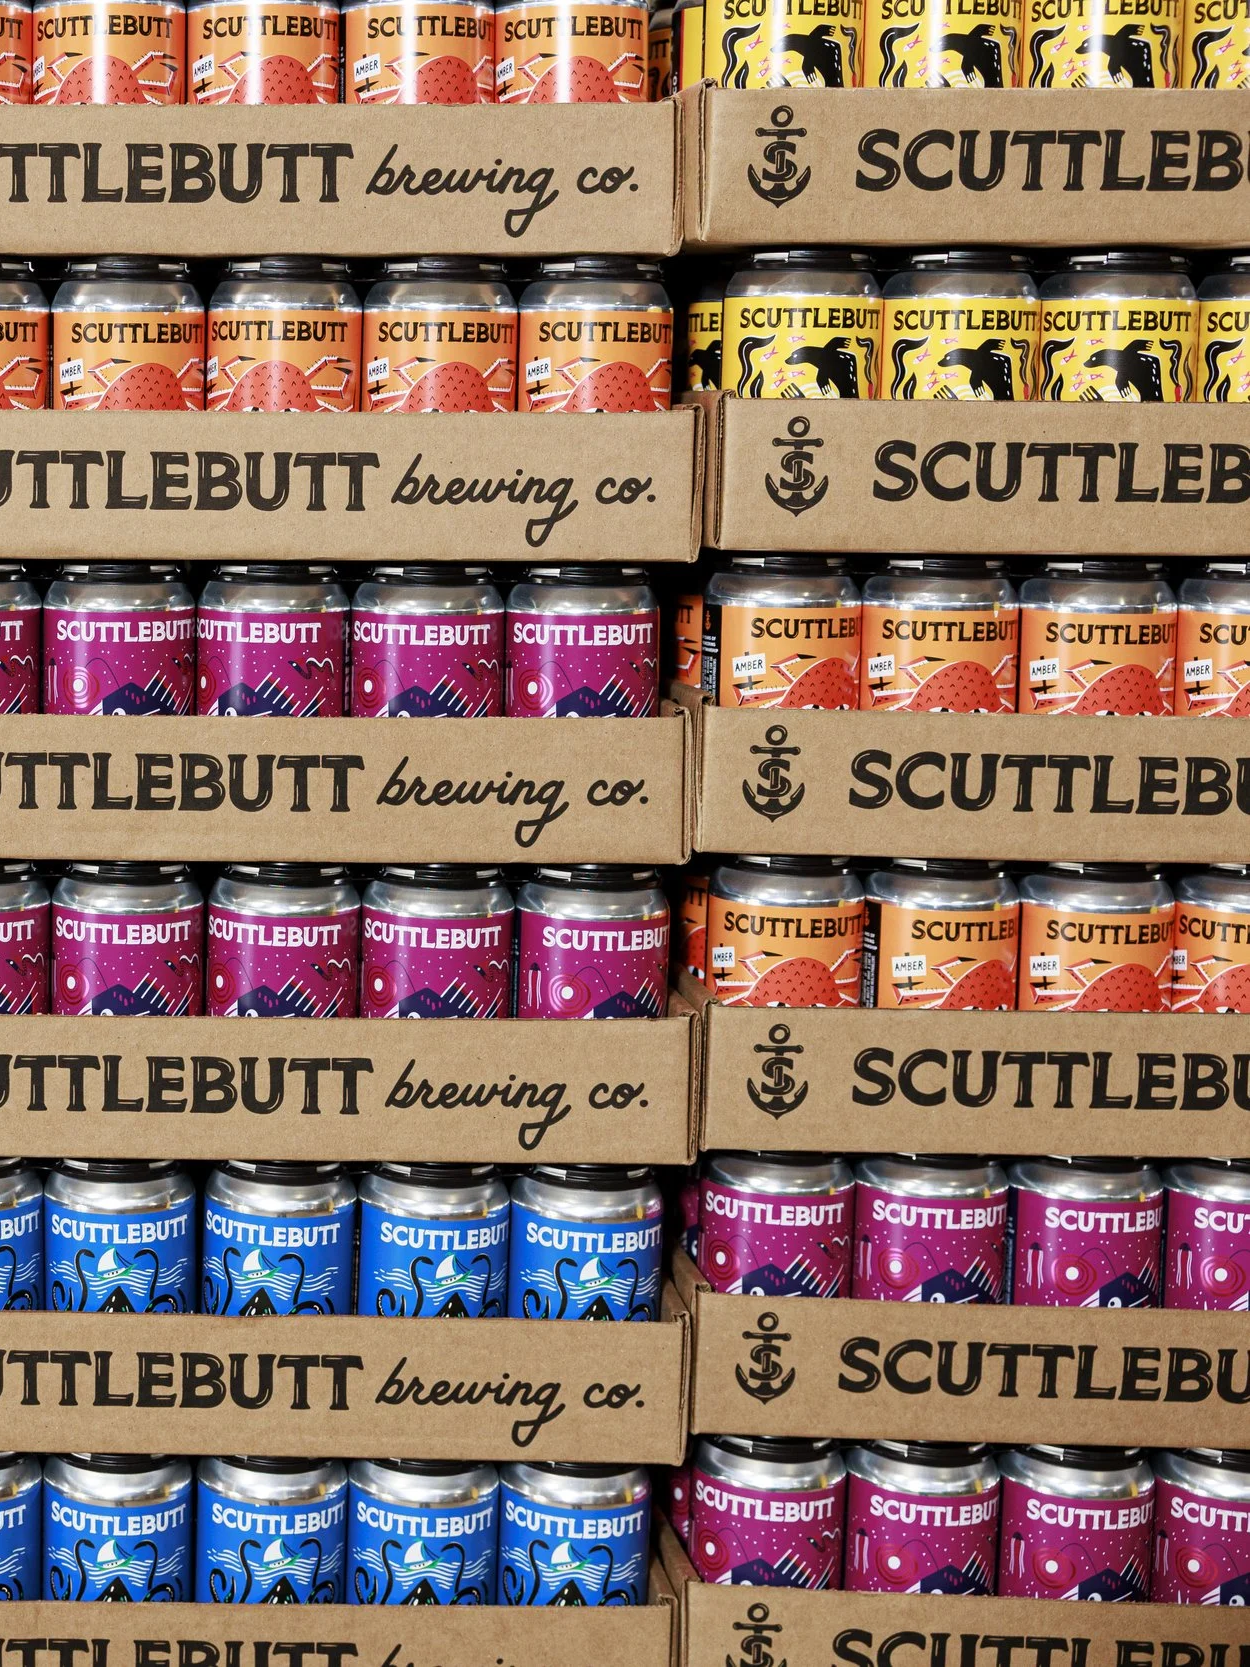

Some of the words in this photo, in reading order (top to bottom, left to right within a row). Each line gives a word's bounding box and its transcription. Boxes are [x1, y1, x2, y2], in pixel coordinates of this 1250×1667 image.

[193, 60, 213, 77] AMBER
[355, 59, 379, 76] AMBER
[855, 129, 1250, 193] SCUTTLEB
[365, 143, 559, 239] brewing
[576, 163, 640, 194] co.
[740, 308, 882, 330] SCUTTLEBUTT
[893, 310, 1038, 332] SCUTTLEBUTT
[1043, 312, 1192, 332] SCUTTLEBUTT
[211, 322, 348, 344] SCUTTLEBUTT
[378, 321, 515, 344] SCUTTLEBUTT
[61, 364, 82, 378] AMBER
[369, 363, 388, 377] AMBER
[528, 362, 550, 378] AMBER
[388, 453, 581, 548] brewing
[595, 474, 658, 503] co.
[57, 621, 191, 643] SCUTTLEBUTT
[353, 623, 491, 645] SCUTTLEBUTT
[513, 623, 654, 646] SCUTTLEBUTT
[1199, 623, 1250, 645] SCU
[735, 659, 764, 672] AMBER
[869, 660, 893, 673] AMBER
[1031, 662, 1058, 676] AMBER
[1186, 664, 1210, 677] AMBER
[376, 757, 570, 847] brewing
[586, 778, 650, 808] co.
[56, 916, 191, 945] SCUTTLEBUTT
[208, 915, 342, 947] SCUTTLEBUTT
[365, 917, 502, 949] SCUTTLEBUTT
[723, 911, 862, 939] SCUTTLEBUTT
[714, 951, 733, 962] AMBER
[894, 960, 924, 971] AMBER
[1032, 960, 1057, 972] AMBER
[385, 1059, 572, 1151] brewing
[588, 1079, 650, 1110] co.
[705, 1191, 845, 1227] SCUTTLEBUTT
[51, 1215, 188, 1243] SCUTTLEBUTT
[206, 1210, 341, 1248] SCUTTLEBUTT
[526, 1222, 662, 1253] SCUTTLEBUTT
[375, 1357, 566, 1447] brewing
[584, 1379, 646, 1408] co.
[695, 1480, 834, 1523] SCUTTLEBUTT
[51, 1500, 186, 1536] SCUTTLEBUTT
[212, 1500, 346, 1536] SCUTTLEBUTT
[356, 1501, 493, 1539] SCUTTLEBUTT
[505, 1501, 644, 1540] SCUTTLEBUTT
